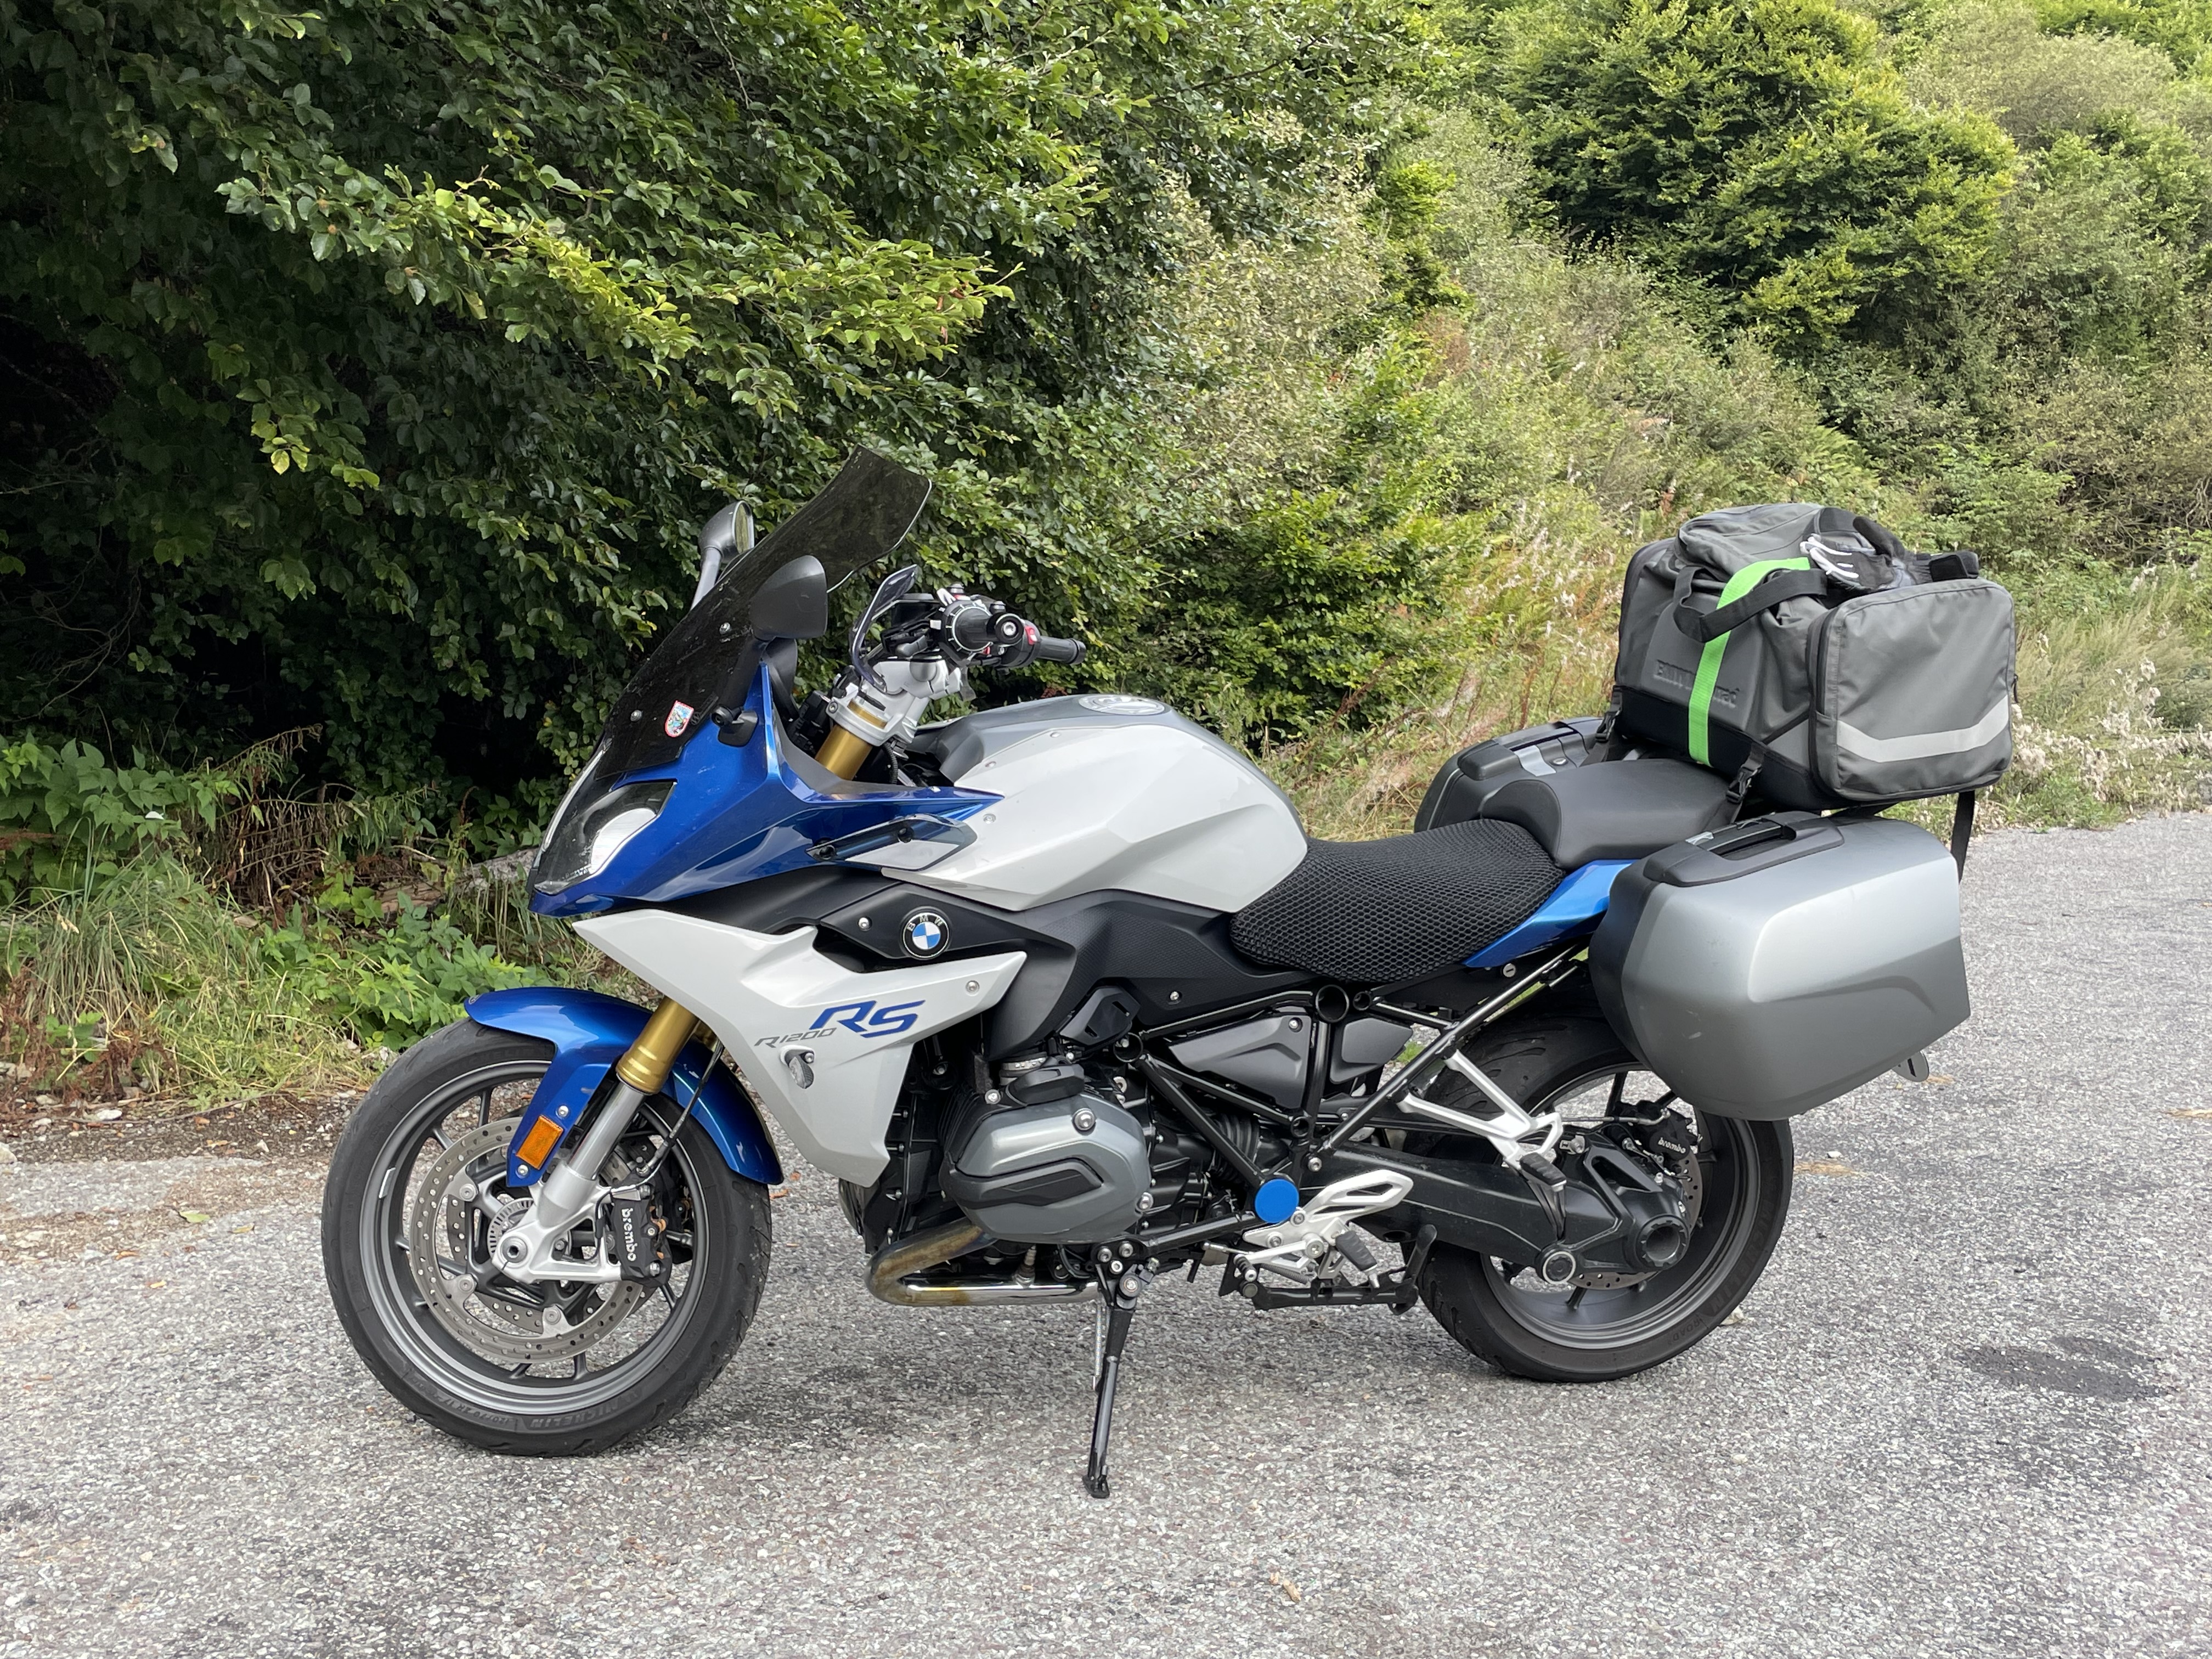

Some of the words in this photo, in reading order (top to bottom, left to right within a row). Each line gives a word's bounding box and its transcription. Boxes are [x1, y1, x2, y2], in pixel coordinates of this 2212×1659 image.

[906, 915, 944, 932] BMW
[809, 1000, 926, 1039] RS
[1658, 1137, 1686, 1154] brembo
[622, 1208, 638, 1261] brembo
